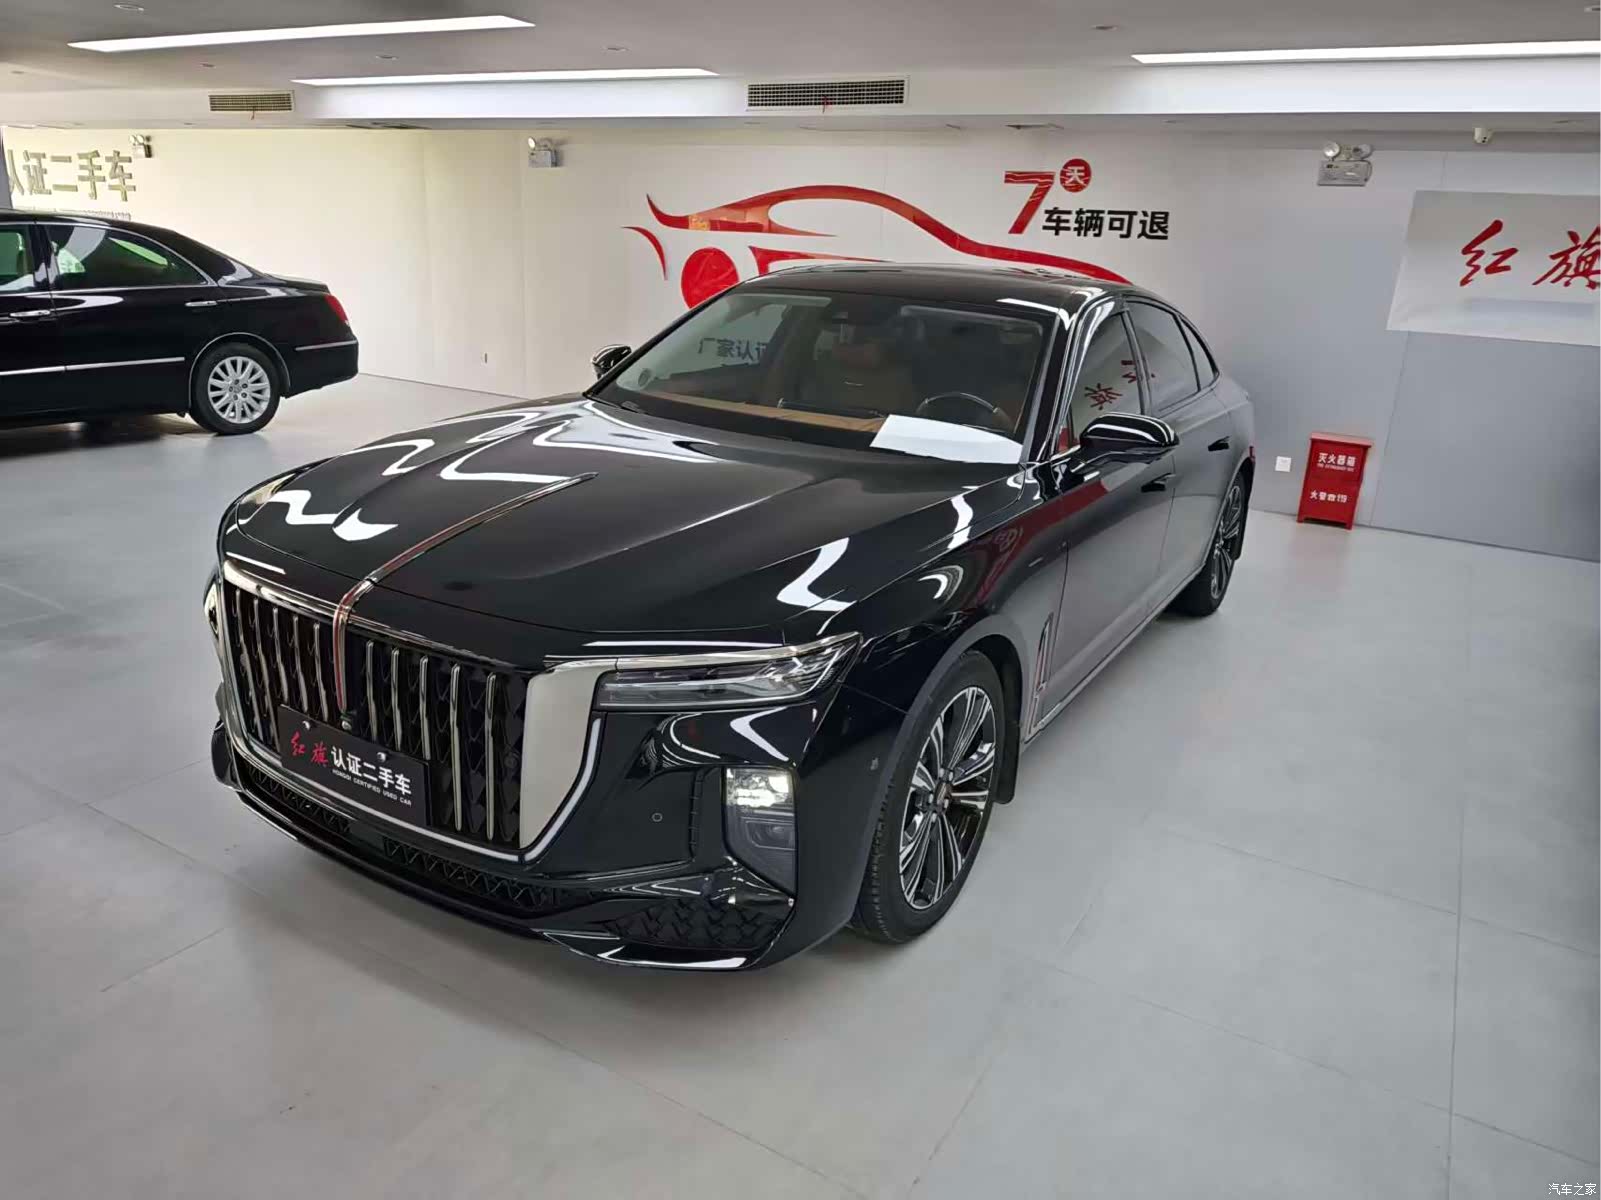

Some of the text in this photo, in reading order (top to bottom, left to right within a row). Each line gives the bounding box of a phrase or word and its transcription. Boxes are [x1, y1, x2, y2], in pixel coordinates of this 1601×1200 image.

[1042, 207, 1170, 240] 车辆可退
[1318, 453, 1356, 467] 灭火器箱
[353, 777, 381, 795] CERTIFIED
[382, 789, 398, 801] USED
[399, 796, 412, 808] CAR
